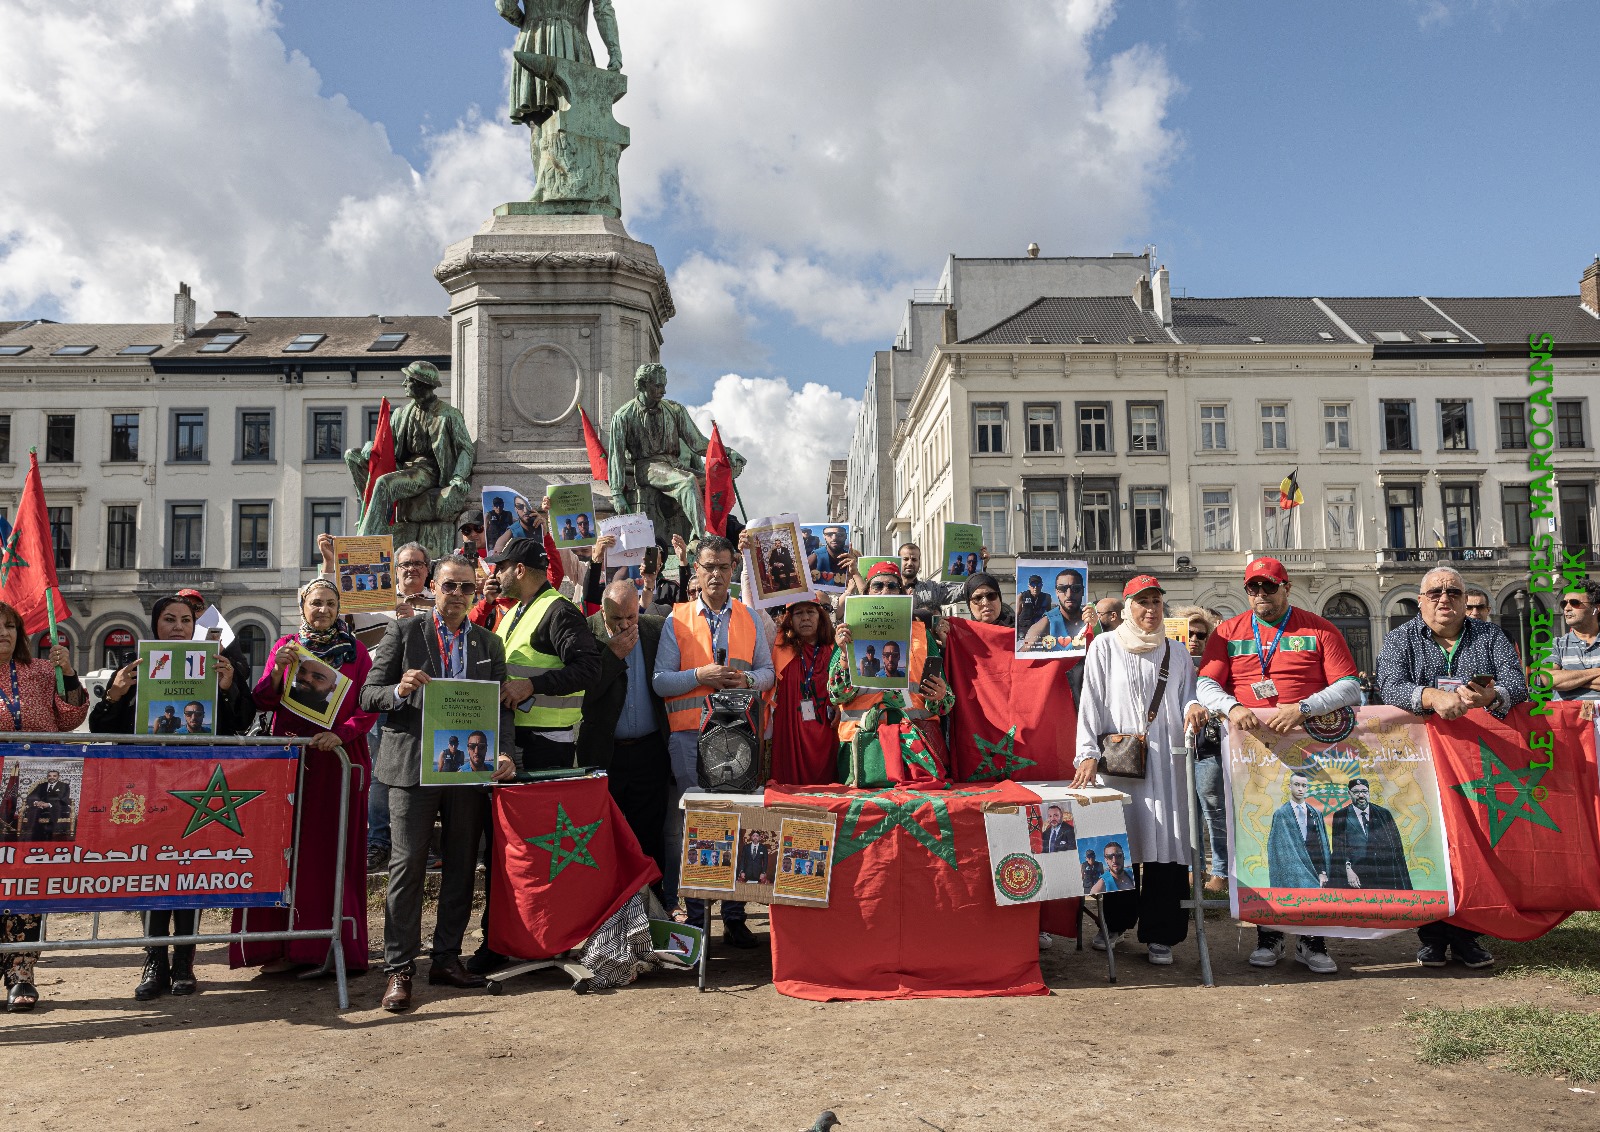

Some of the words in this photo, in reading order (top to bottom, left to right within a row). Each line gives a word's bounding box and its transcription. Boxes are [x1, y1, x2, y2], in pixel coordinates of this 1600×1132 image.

[164, 687, 195, 695] JUSTICE
[24, 844, 149, 865] الصداقة
[156, 845, 254, 865] جمعية
[46, 873, 171, 895] EUROPEEN
[176, 872, 254, 891] MAROC
